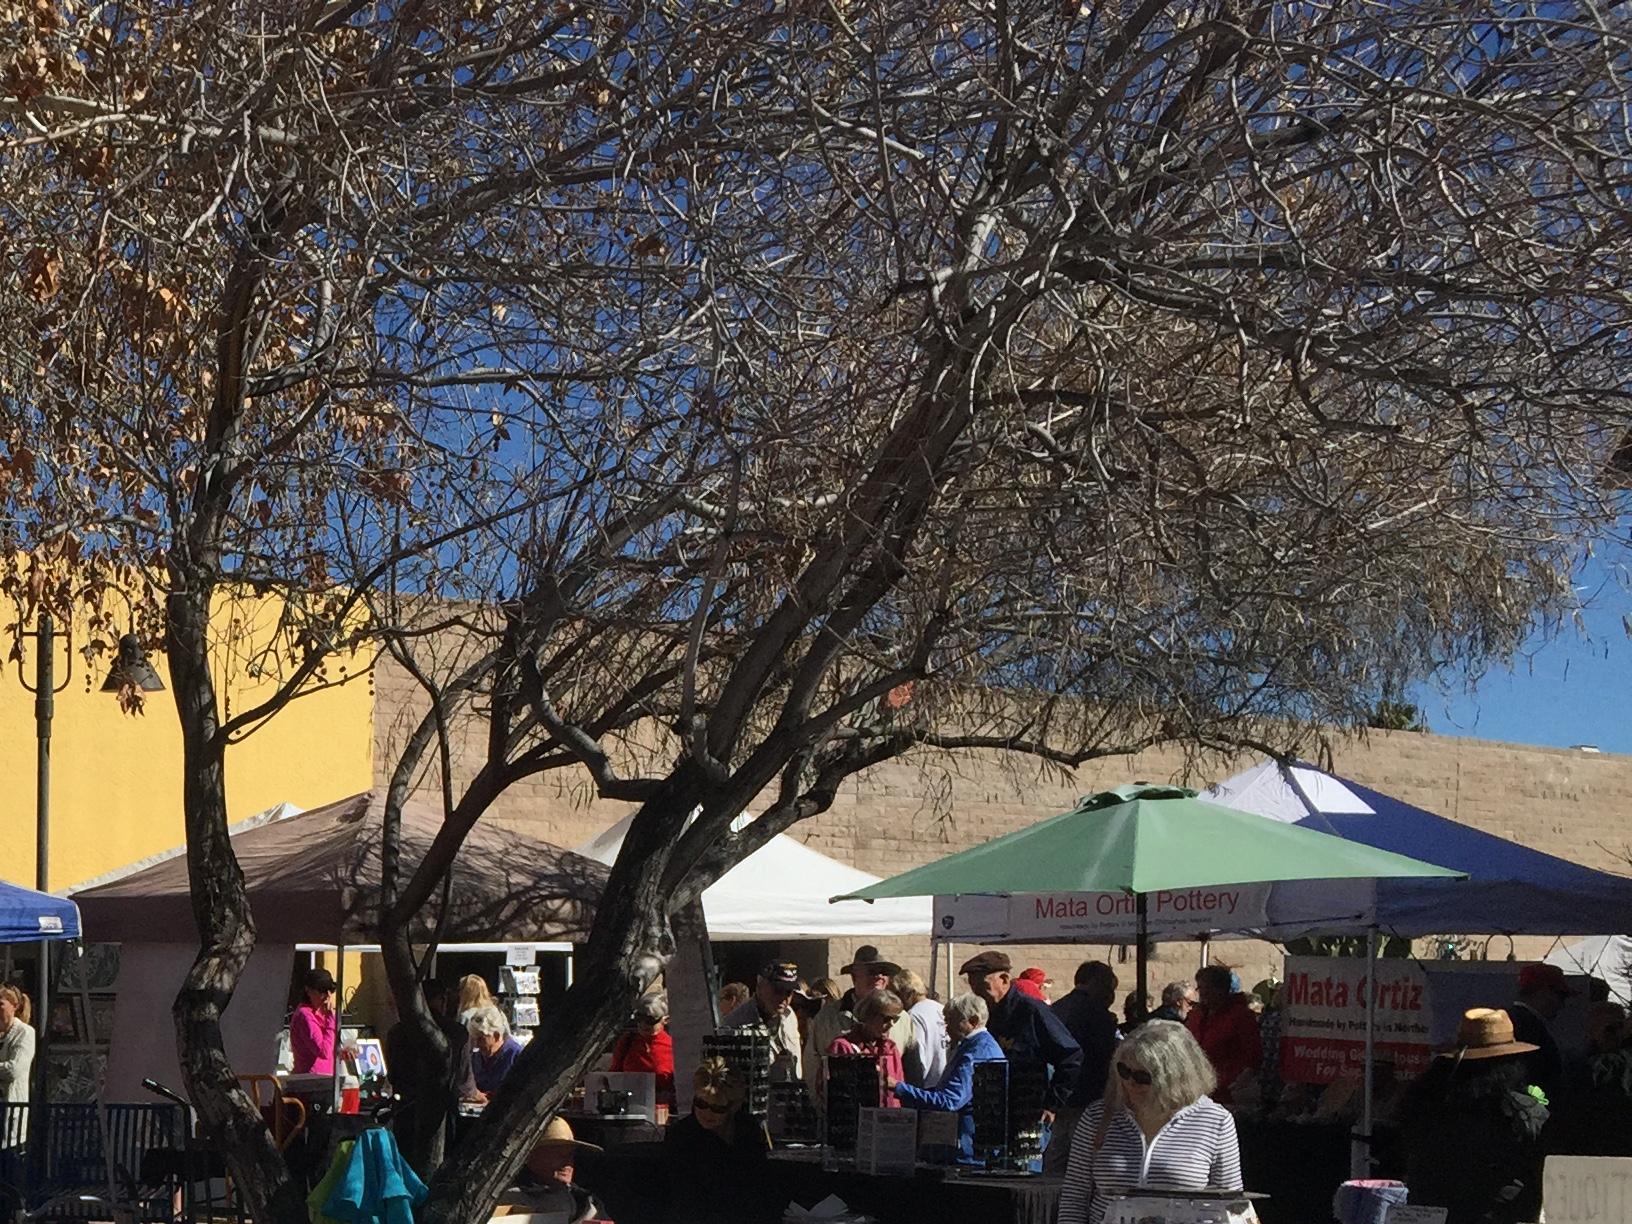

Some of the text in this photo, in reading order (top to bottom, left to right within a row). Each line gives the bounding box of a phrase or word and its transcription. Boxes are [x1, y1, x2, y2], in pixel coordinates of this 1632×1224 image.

[1035, 889, 1240, 919] Mata Orti Pottery
[1288, 972, 1350, 1008] Mata
[1293, 1045, 1346, 1061] Wedding
